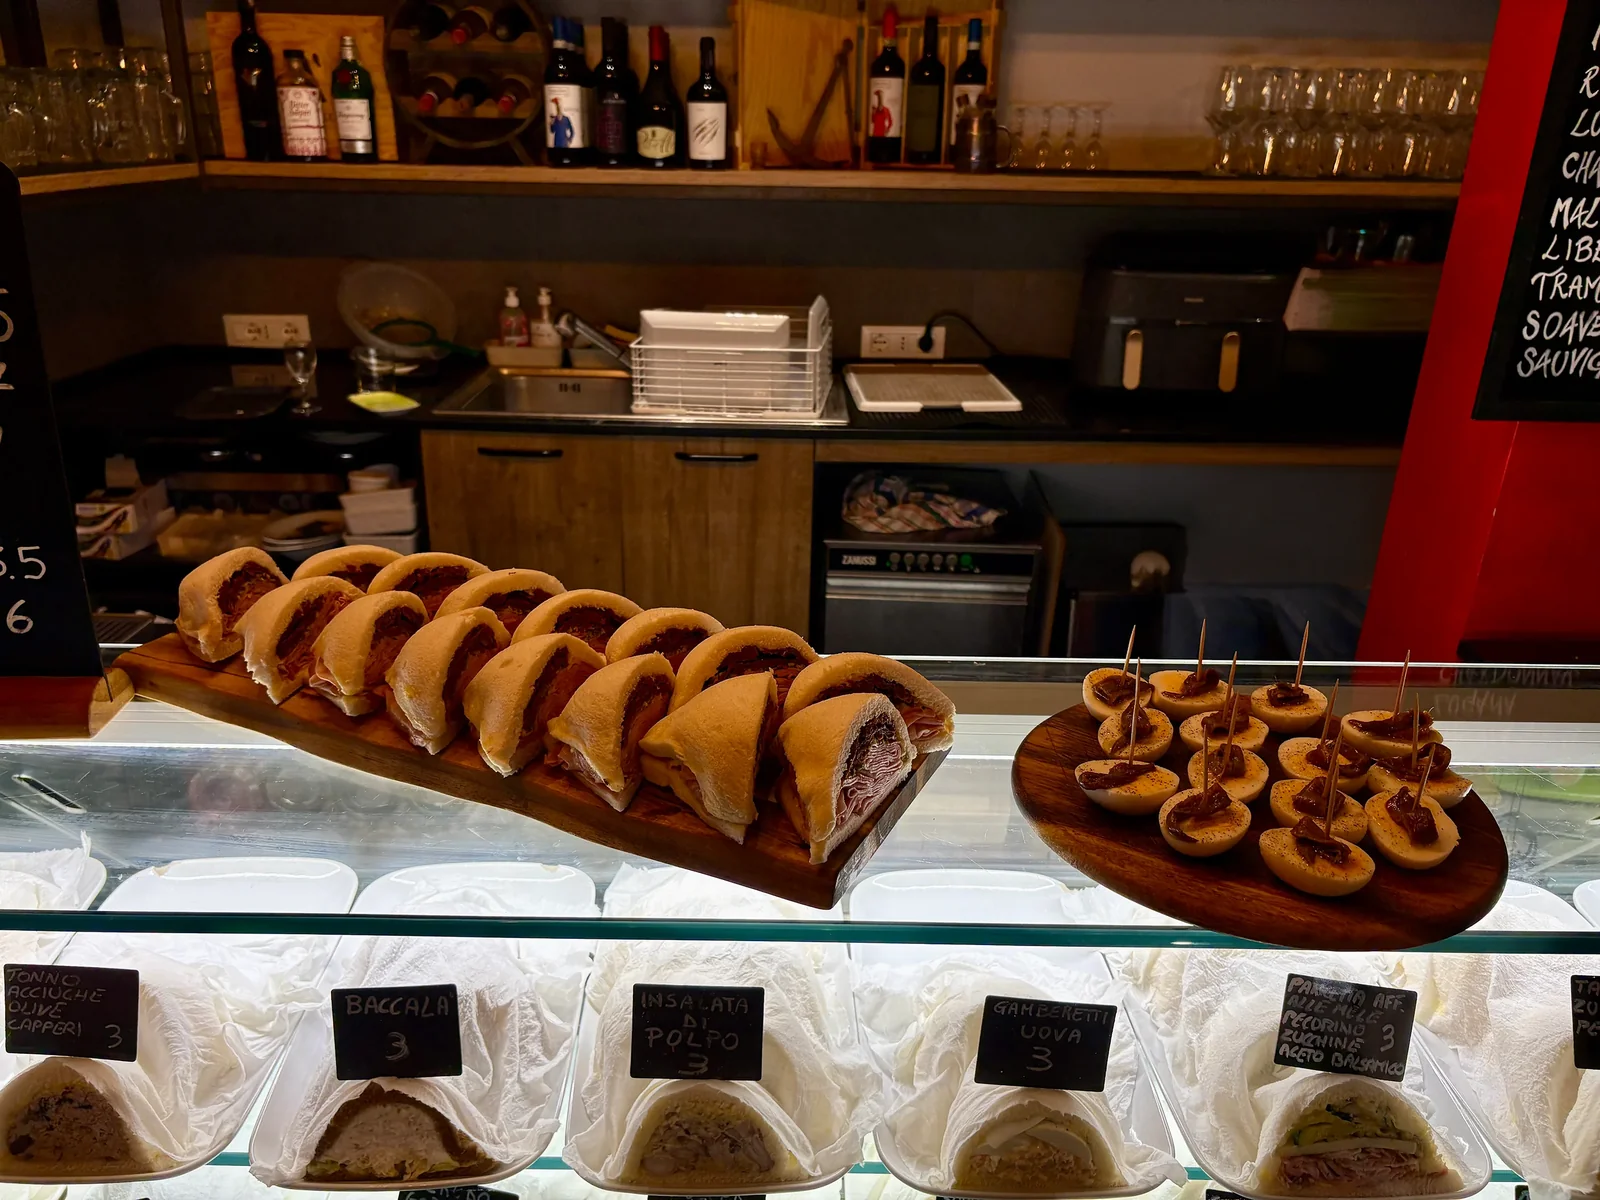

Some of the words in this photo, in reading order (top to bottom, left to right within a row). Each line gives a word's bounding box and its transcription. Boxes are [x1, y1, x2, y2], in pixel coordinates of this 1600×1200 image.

[1550, 197, 1600, 230] MAL
[1522, 309, 1600, 346] SOAVE
[6, 599, 34, 634] 6
[7, 967, 80, 986] TONNO
[8, 1000, 68, 1019] OLIVE
[641, 991, 749, 1014] INSALATA
[993, 1000, 1109, 1025] GAMBERETTI
[7, 1018, 82, 1037] CAPPERI
[682, 1013, 708, 1030] DI
[1020, 1024, 1082, 1044] UOVA
[1281, 1009, 1366, 1036] PECORINO
[104, 1024, 123, 1049] 3
[385, 1031, 410, 1061] 3
[644, 1026, 739, 1053] POLPO
[1380, 1023, 1395, 1052] 3
[677, 1052, 709, 1076] 3
[1026, 1045, 1053, 1072] 3
[1278, 1043, 1325, 1063] ACETO
[1331, 1052, 1405, 1077] BALSAMICO
